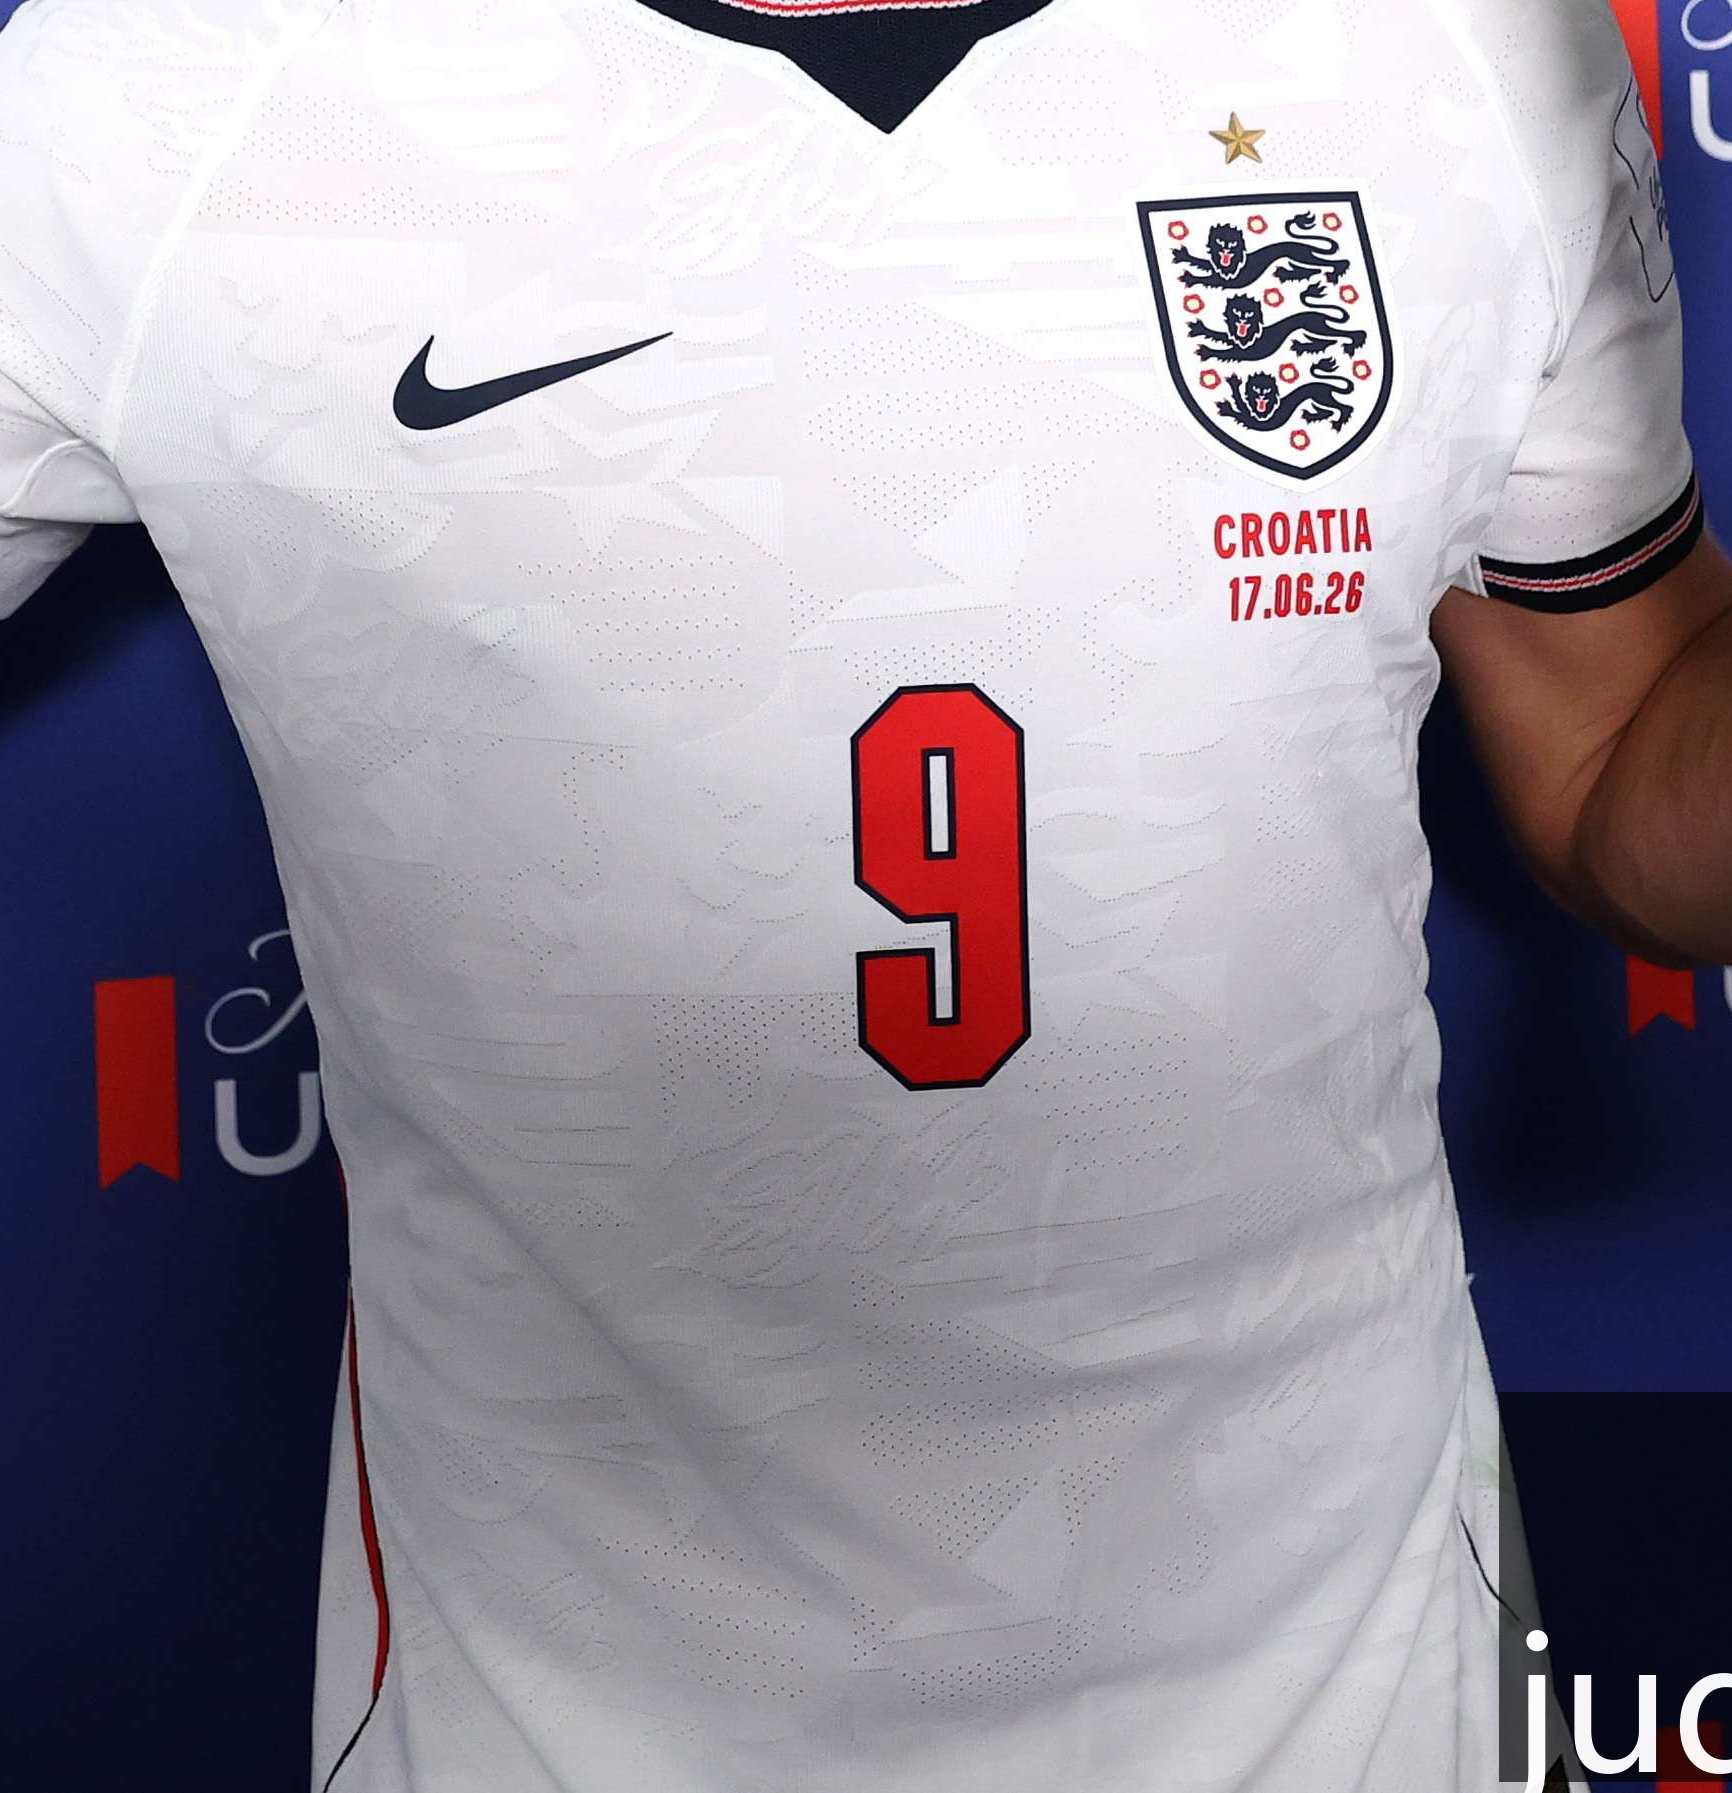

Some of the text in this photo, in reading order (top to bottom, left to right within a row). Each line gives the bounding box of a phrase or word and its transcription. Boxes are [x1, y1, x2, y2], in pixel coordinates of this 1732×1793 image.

[1213, 507, 1372, 559] CROATIA
[1228, 570, 1365, 622] 17.06.26
[850, 682, 1032, 1092] 9
